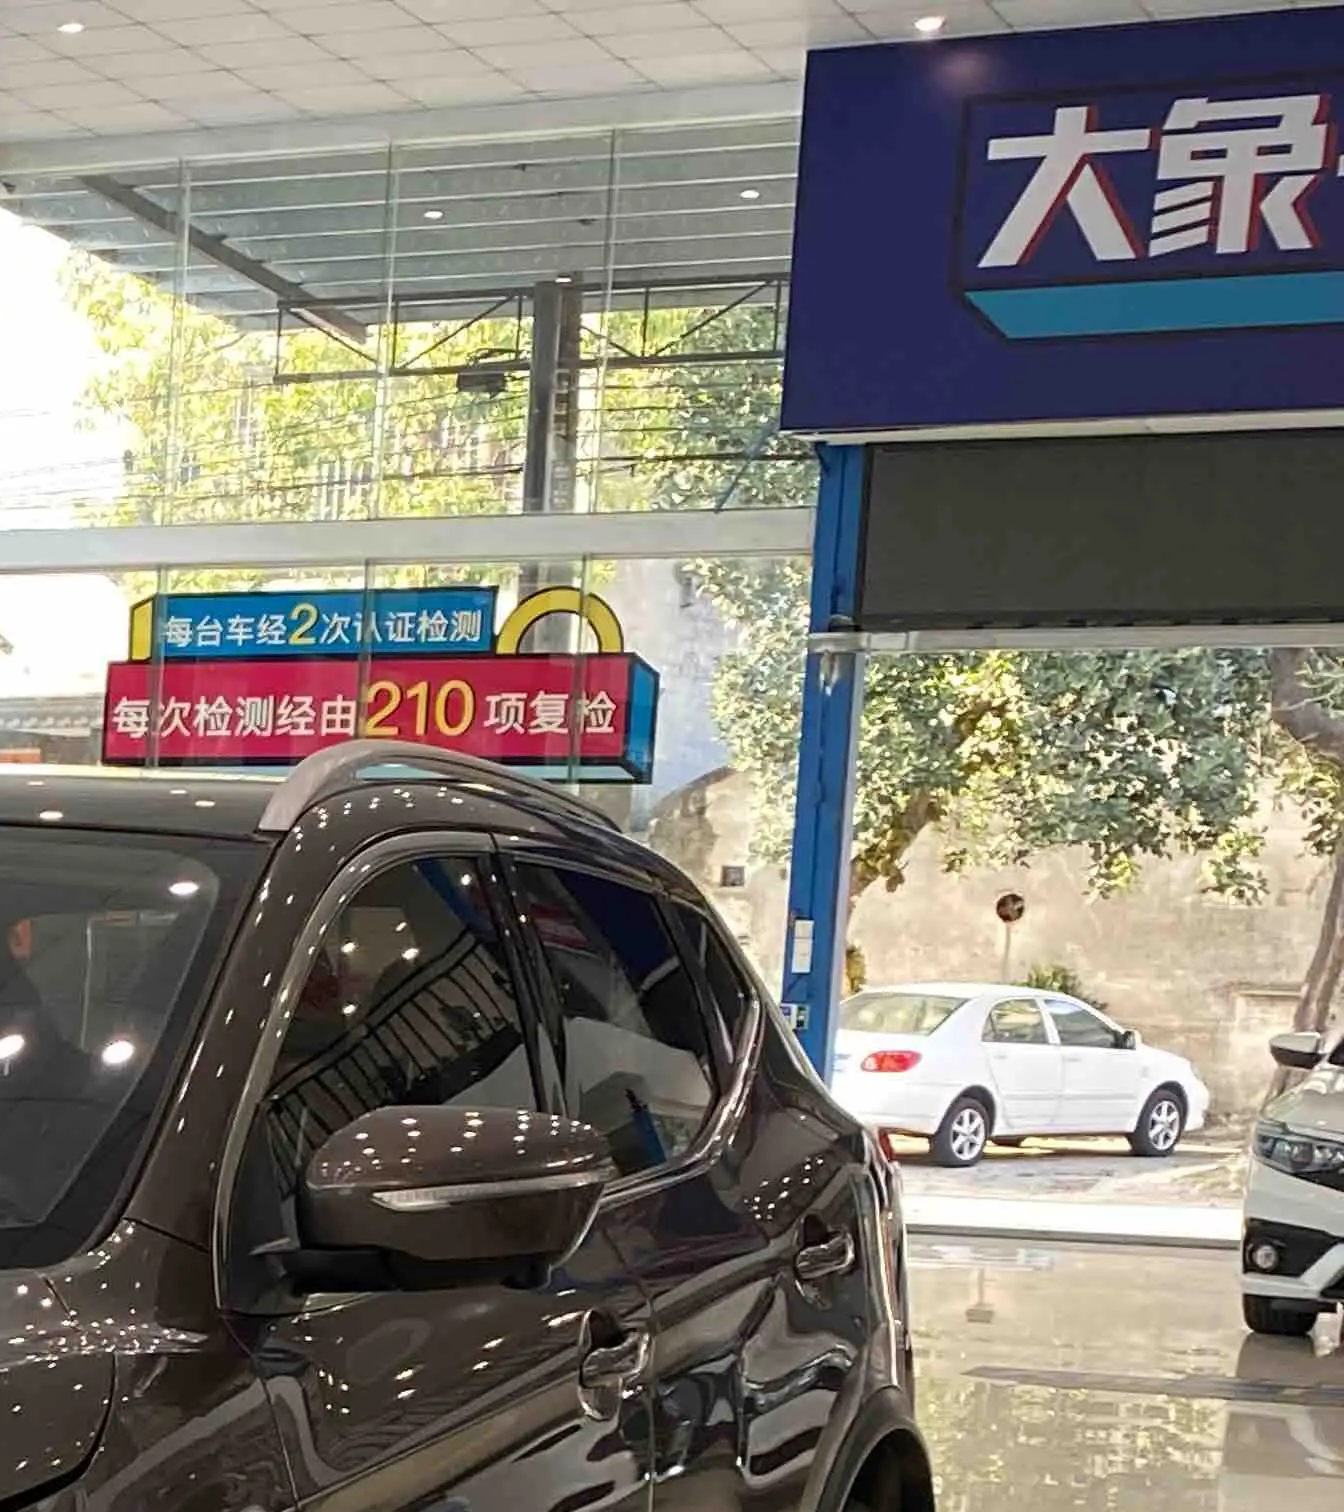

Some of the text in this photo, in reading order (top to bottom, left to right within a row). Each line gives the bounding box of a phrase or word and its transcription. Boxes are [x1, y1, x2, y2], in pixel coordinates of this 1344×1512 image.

[977, 94, 1344, 268] 大象
[163, 603, 483, 648] 每台车经2次认证检测
[112, 679, 618, 739] 每次检测经由210项复检
